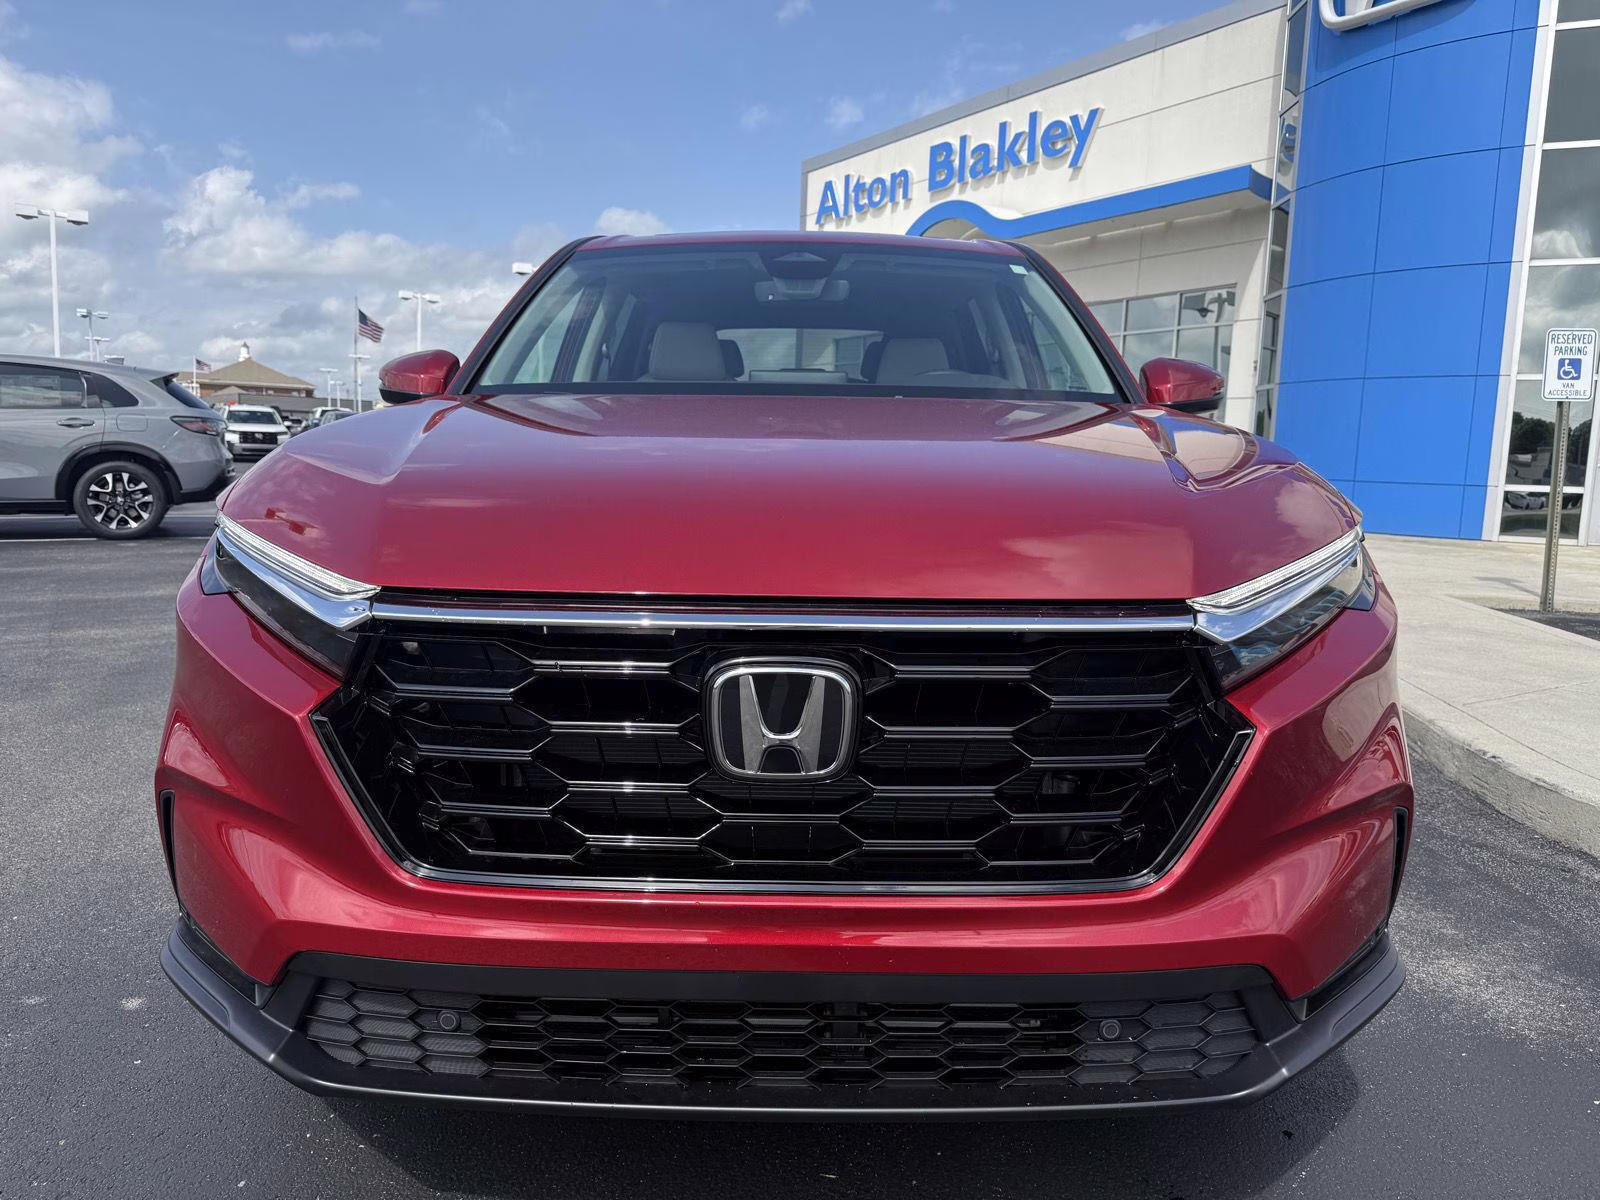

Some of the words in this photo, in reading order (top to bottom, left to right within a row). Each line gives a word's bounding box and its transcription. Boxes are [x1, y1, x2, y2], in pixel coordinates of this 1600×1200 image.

[815, 167, 911, 225] Alton
[928, 106, 1103, 193] Blakley
[1550, 333, 1593, 345] RESERVED
[1553, 345, 1588, 356] PARKING
[1547, 389, 1587, 397] ACCESSIBLE
